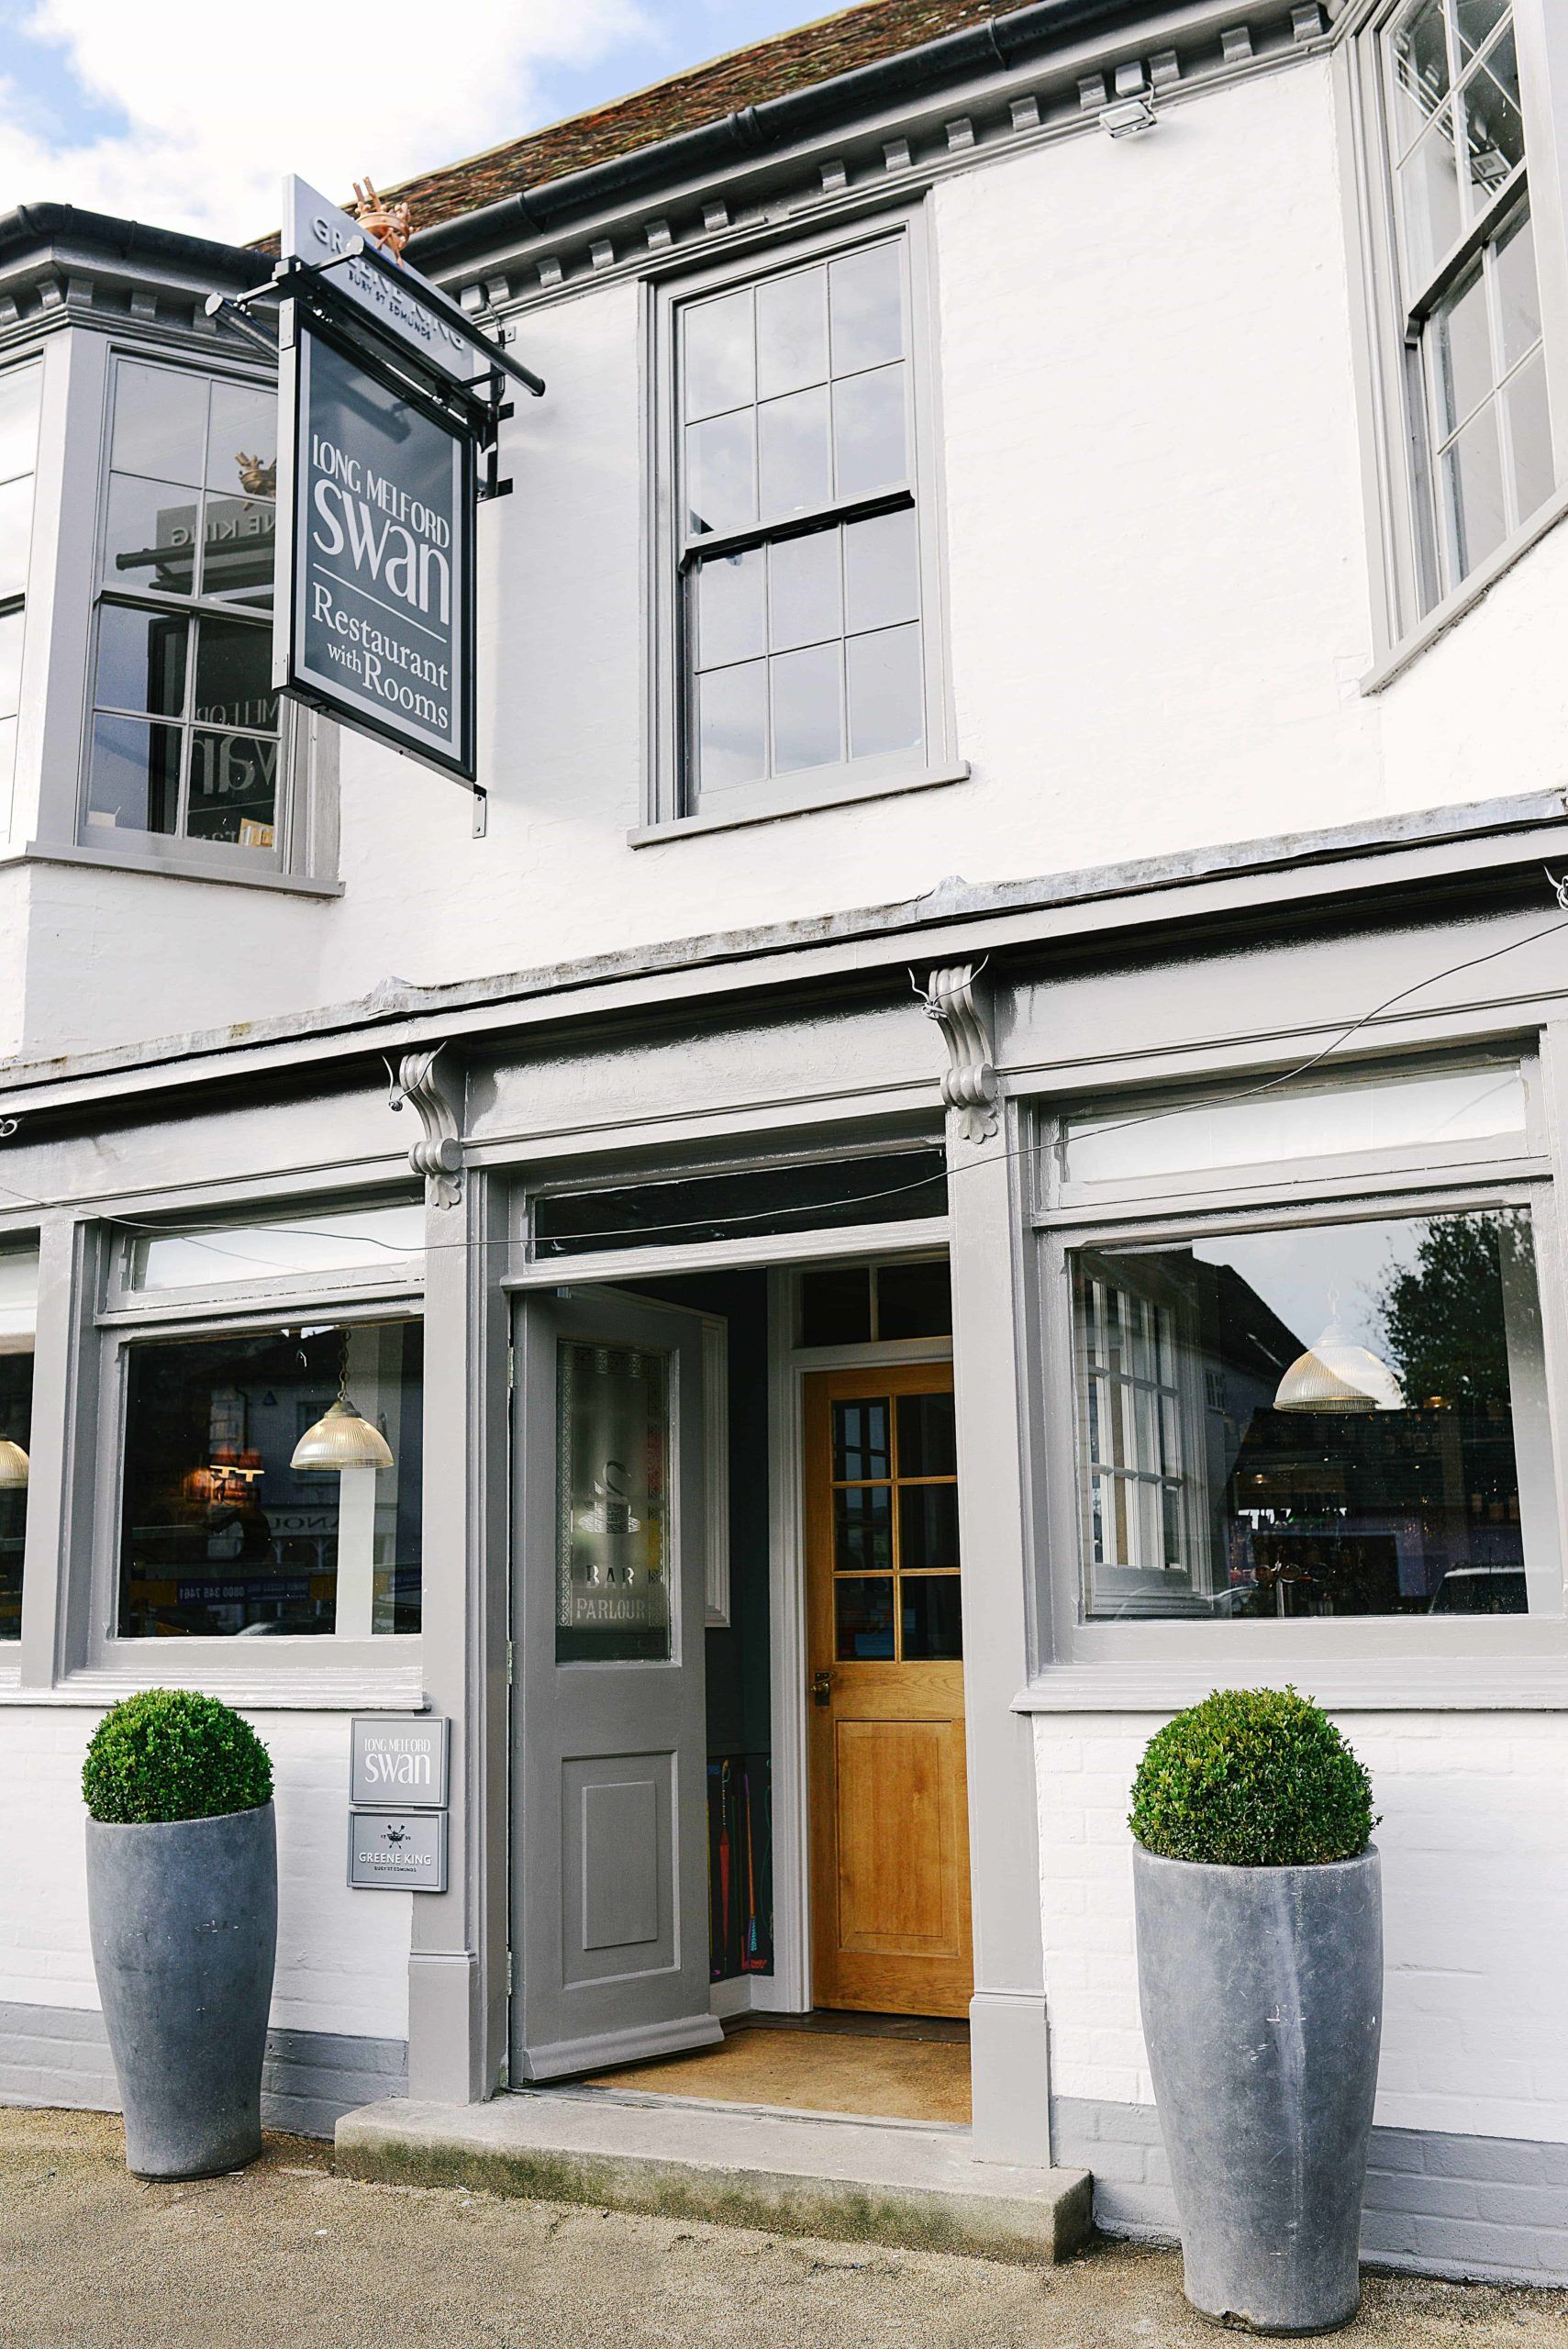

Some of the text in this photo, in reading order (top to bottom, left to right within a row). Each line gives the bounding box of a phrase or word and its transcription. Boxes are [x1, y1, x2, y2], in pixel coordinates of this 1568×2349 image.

[348, 270, 432, 341] BURY ST EDMUNDS
[313, 434, 450, 549] LONG MELFORD
[312, 582, 449, 691] Restaurant
[327, 642, 449, 730] with Rooms
[586, 1564, 635, 1589] BAR
[576, 1598, 646, 1620] PARLOUR
[364, 1738, 431, 1752] LONG MELFORD
[359, 1852, 432, 1865] GREENE KING
